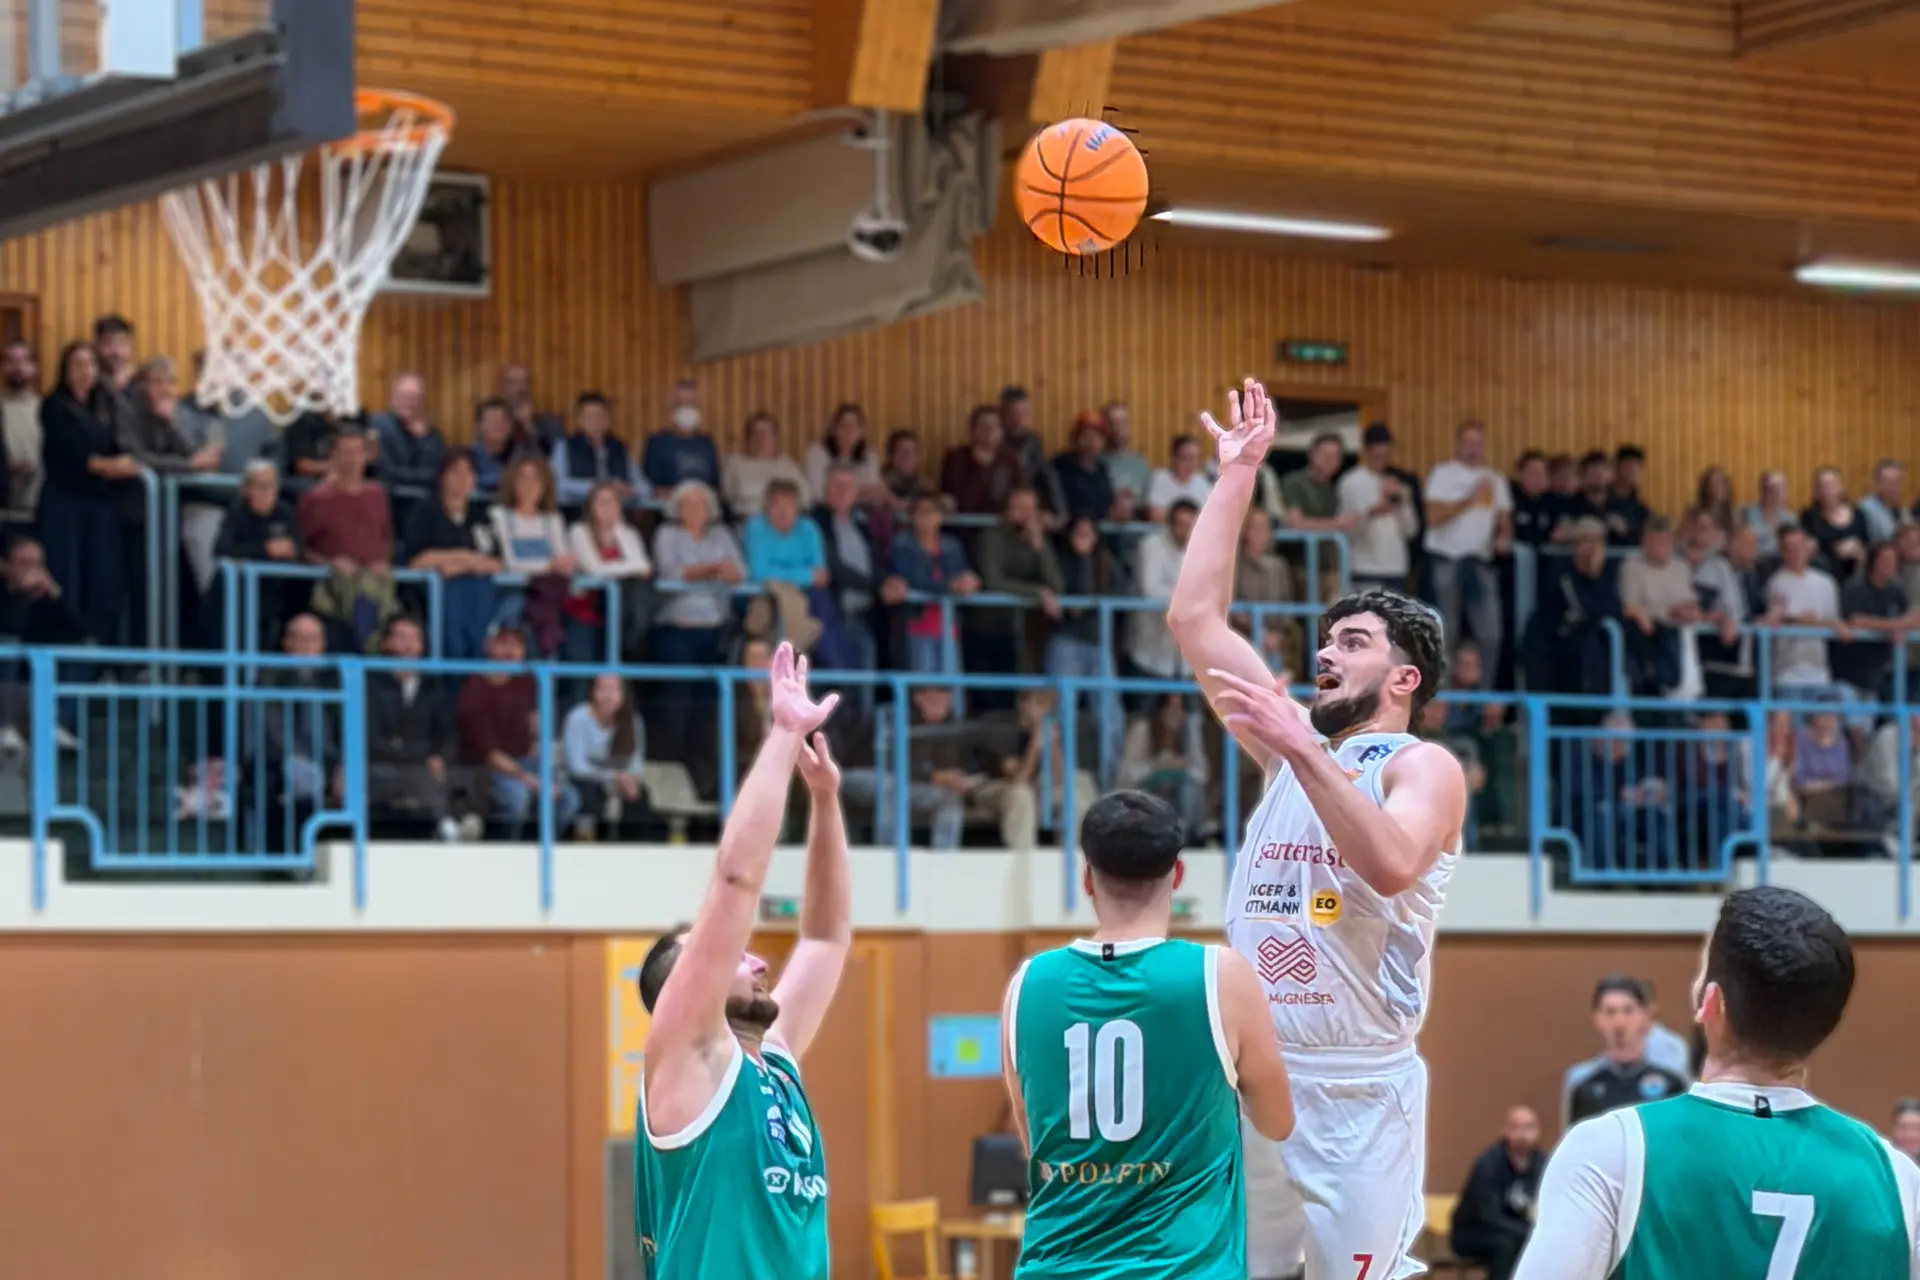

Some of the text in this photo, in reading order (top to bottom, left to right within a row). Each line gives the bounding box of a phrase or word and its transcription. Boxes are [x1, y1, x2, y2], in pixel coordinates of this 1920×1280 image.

[1064, 1019, 1144, 1142] 10
[1352, 1253, 1373, 1280] 7
[1751, 1189, 1815, 1280] 7
